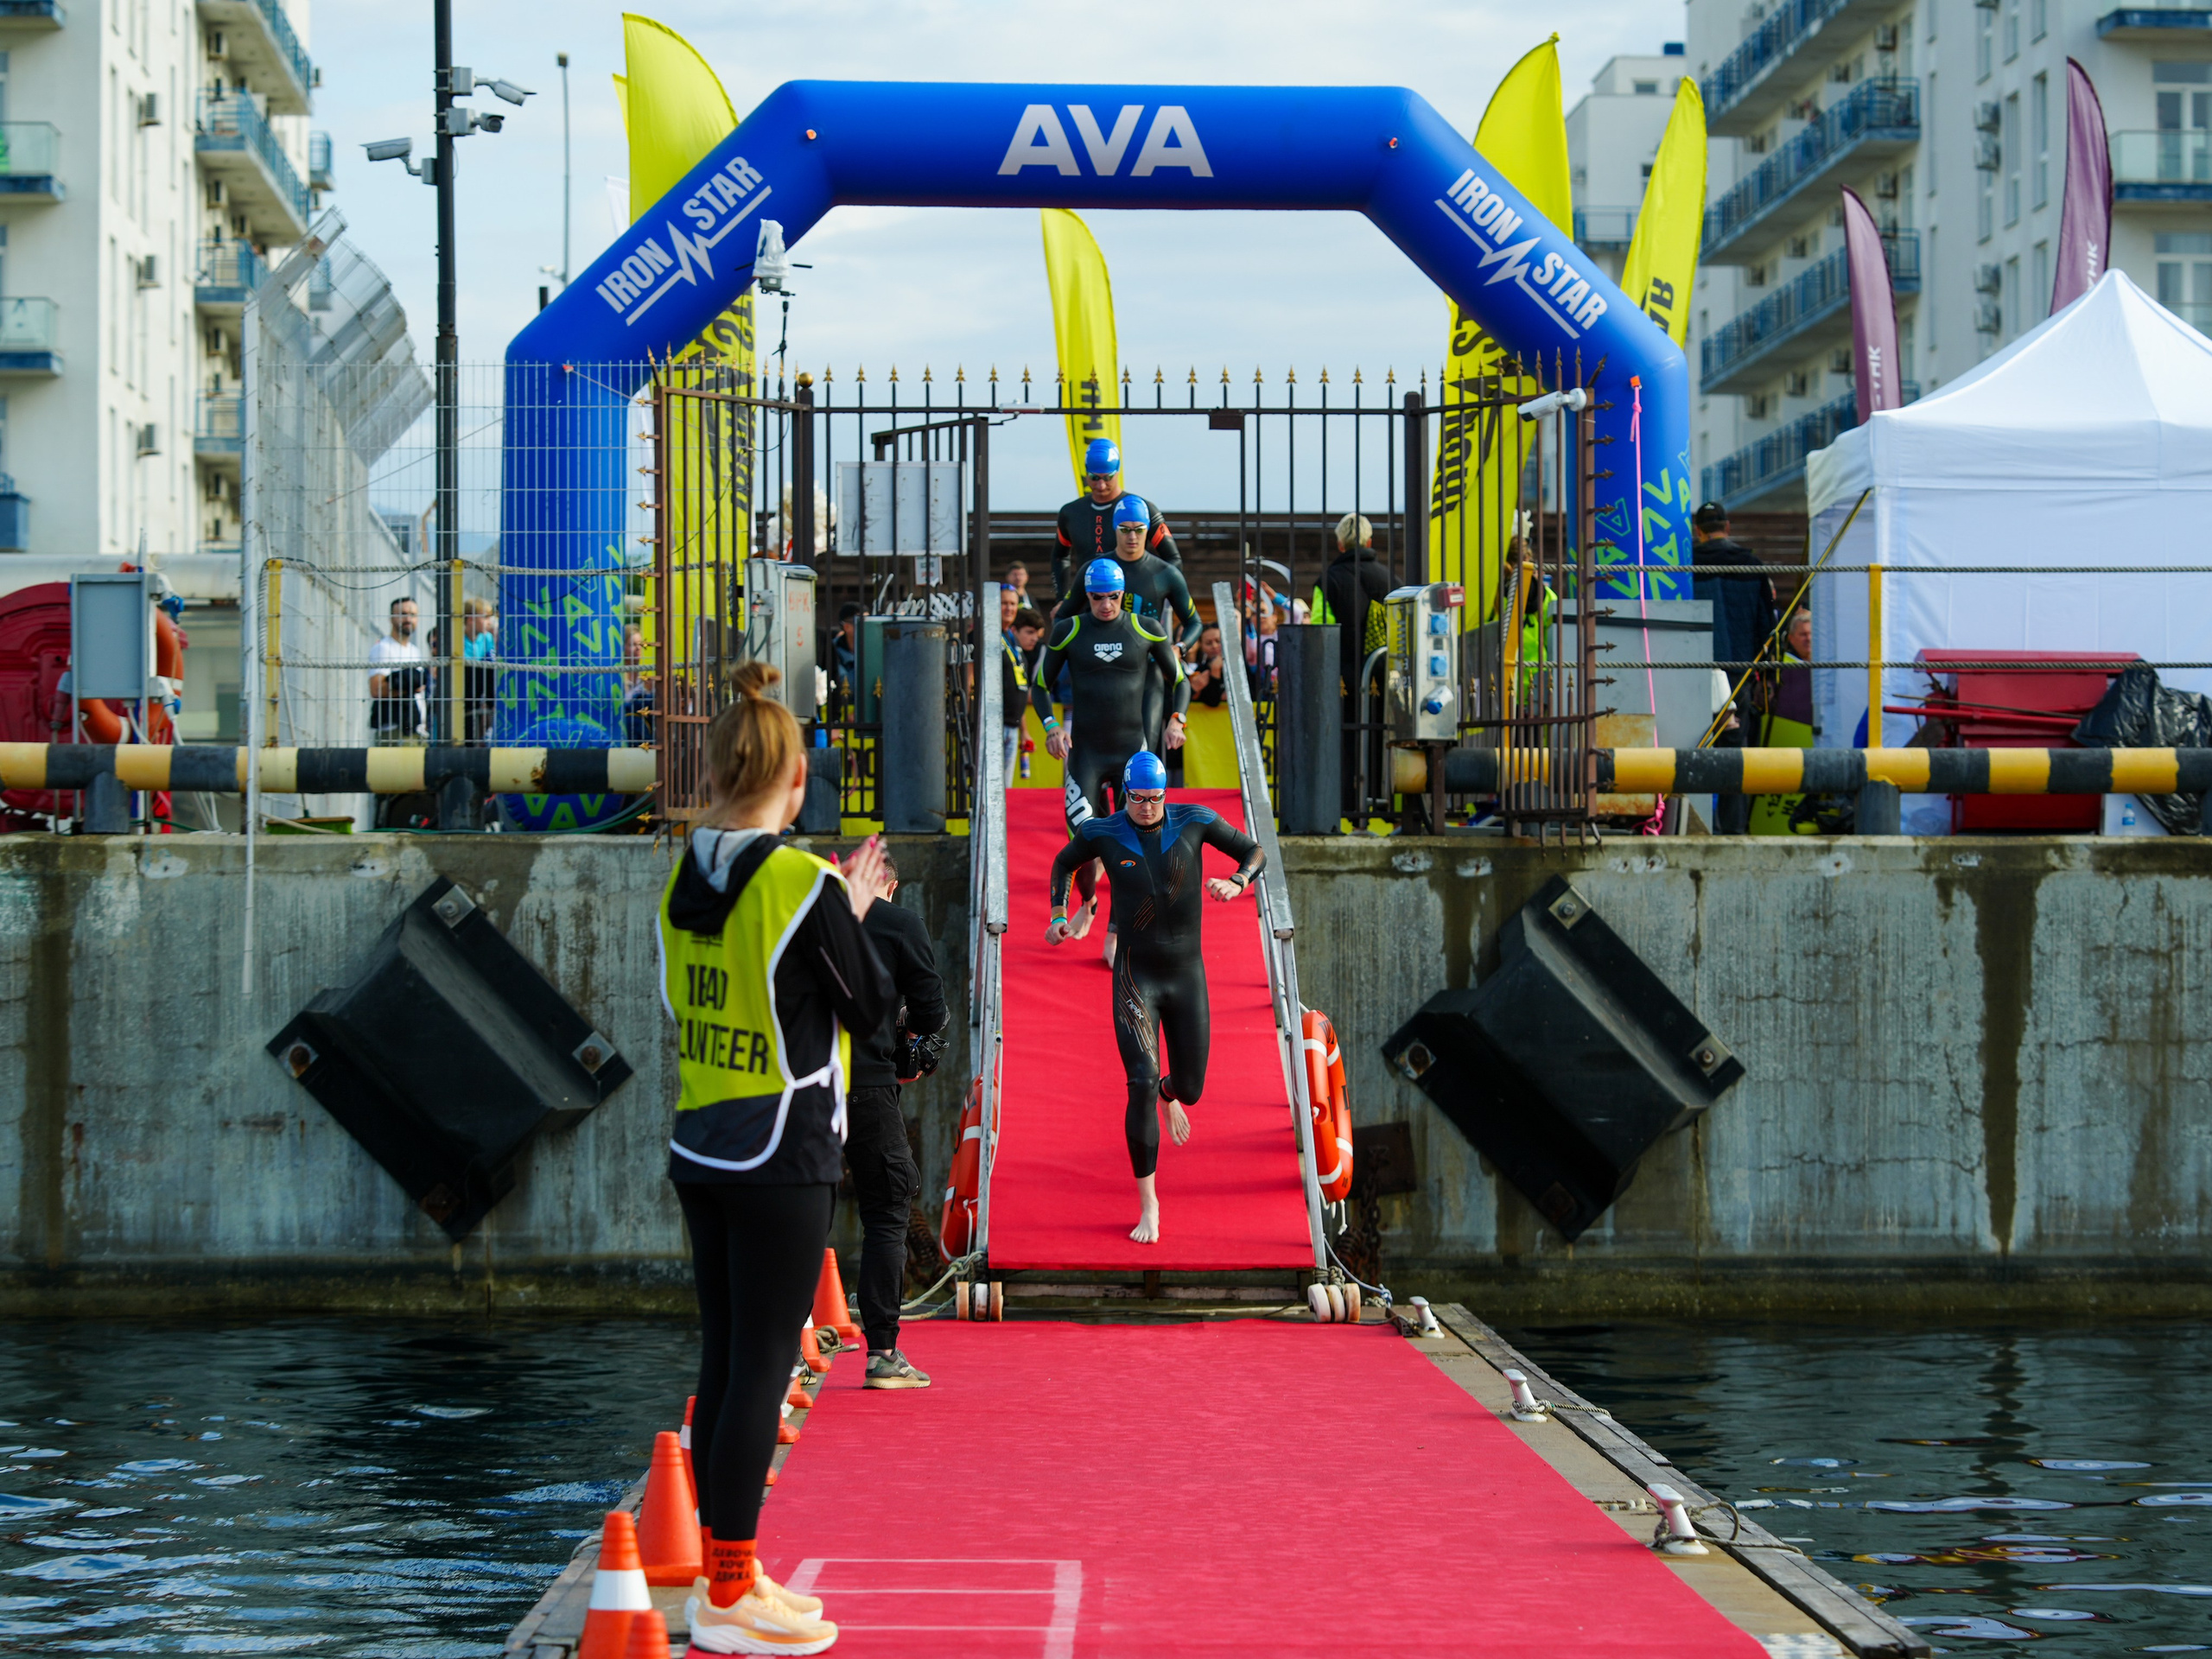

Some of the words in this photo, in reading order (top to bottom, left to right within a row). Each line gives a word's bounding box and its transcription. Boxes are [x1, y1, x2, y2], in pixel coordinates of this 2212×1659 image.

[997, 104, 1214, 178] AVA
[594, 237, 675, 315] IRON
[682, 156, 764, 231] STAR
[1446, 168, 1524, 245] IRON
[1532, 251, 1608, 331] STAR
[1094, 642, 1123, 652] arena
[1126, 998, 1145, 1020] helix
